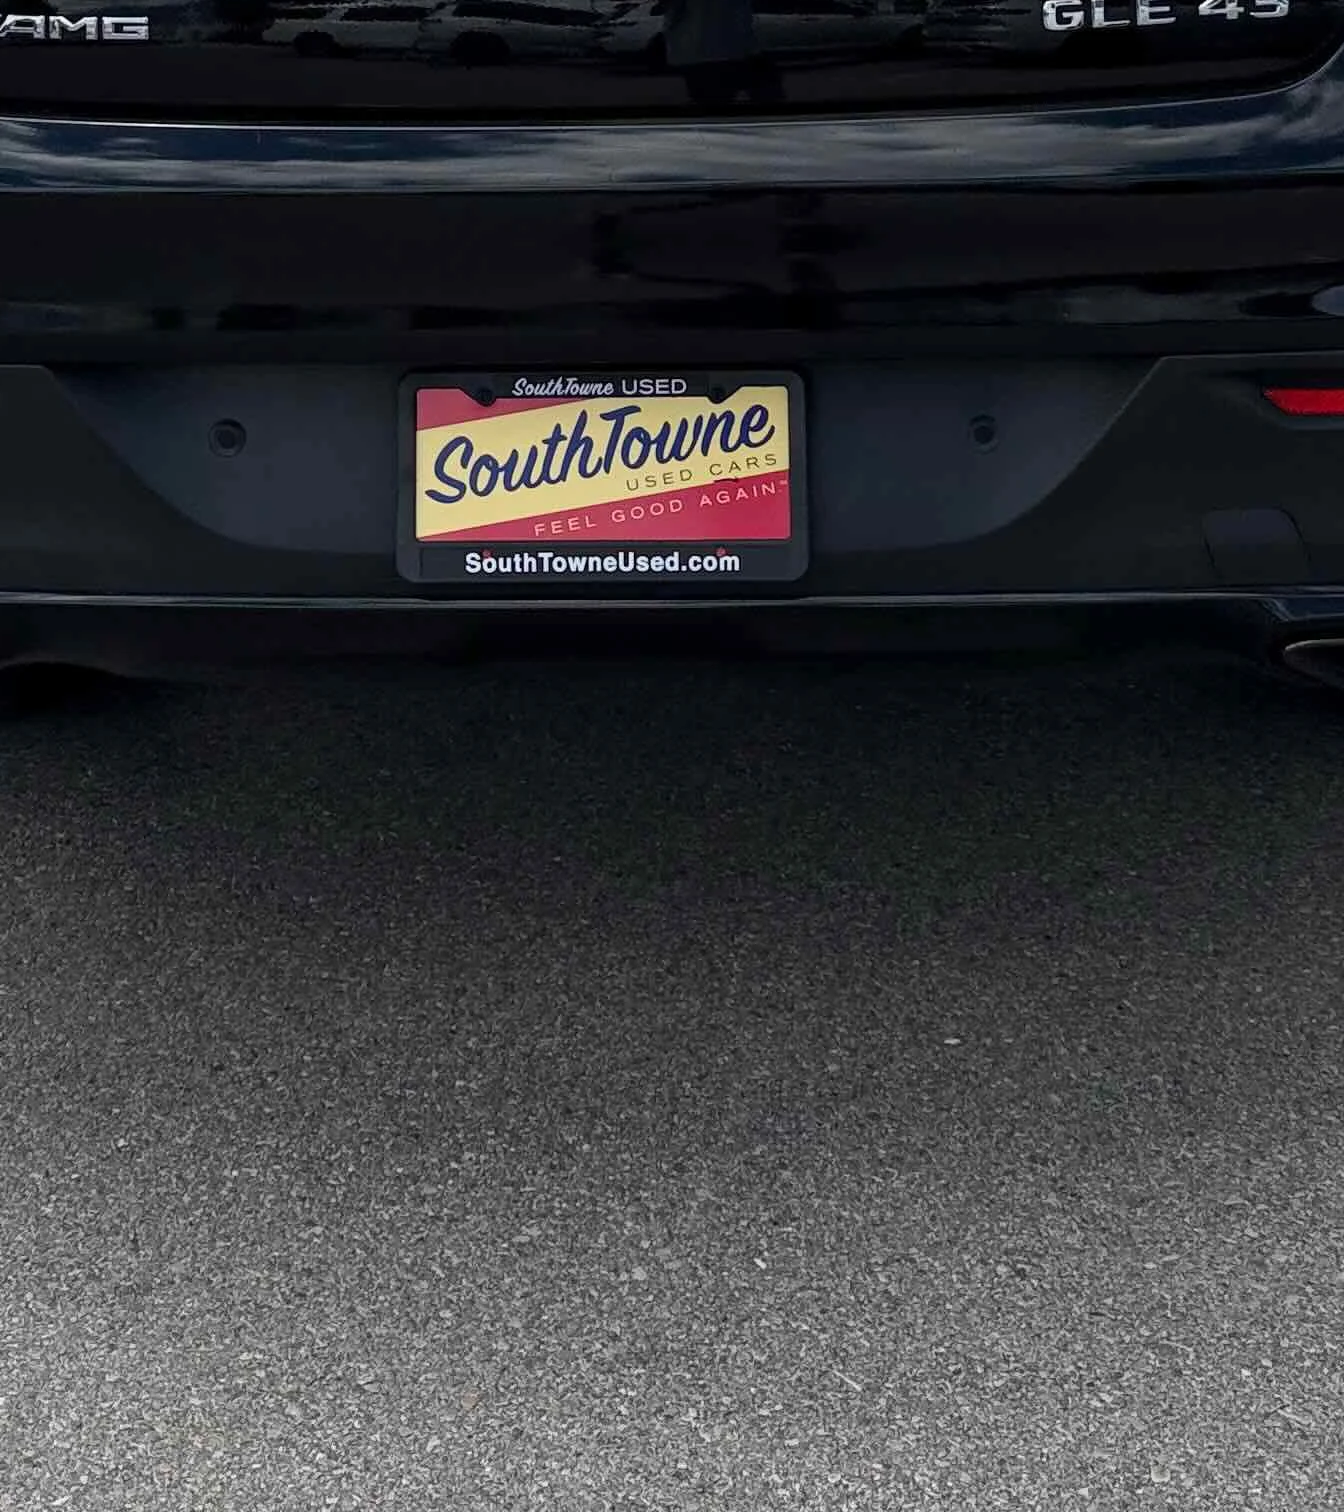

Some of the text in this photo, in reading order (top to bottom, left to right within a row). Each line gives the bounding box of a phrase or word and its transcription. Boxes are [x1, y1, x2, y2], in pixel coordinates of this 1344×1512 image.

[512, 376, 687, 396] SouthTowne USED
[425, 404, 775, 504] SouthTowne
[626, 453, 777, 492] USED CARS
[534, 515, 597, 537] FEEL
[611, 499, 683, 523] GOOD
[465, 552, 740, 574] SouthTowneUsed.com
